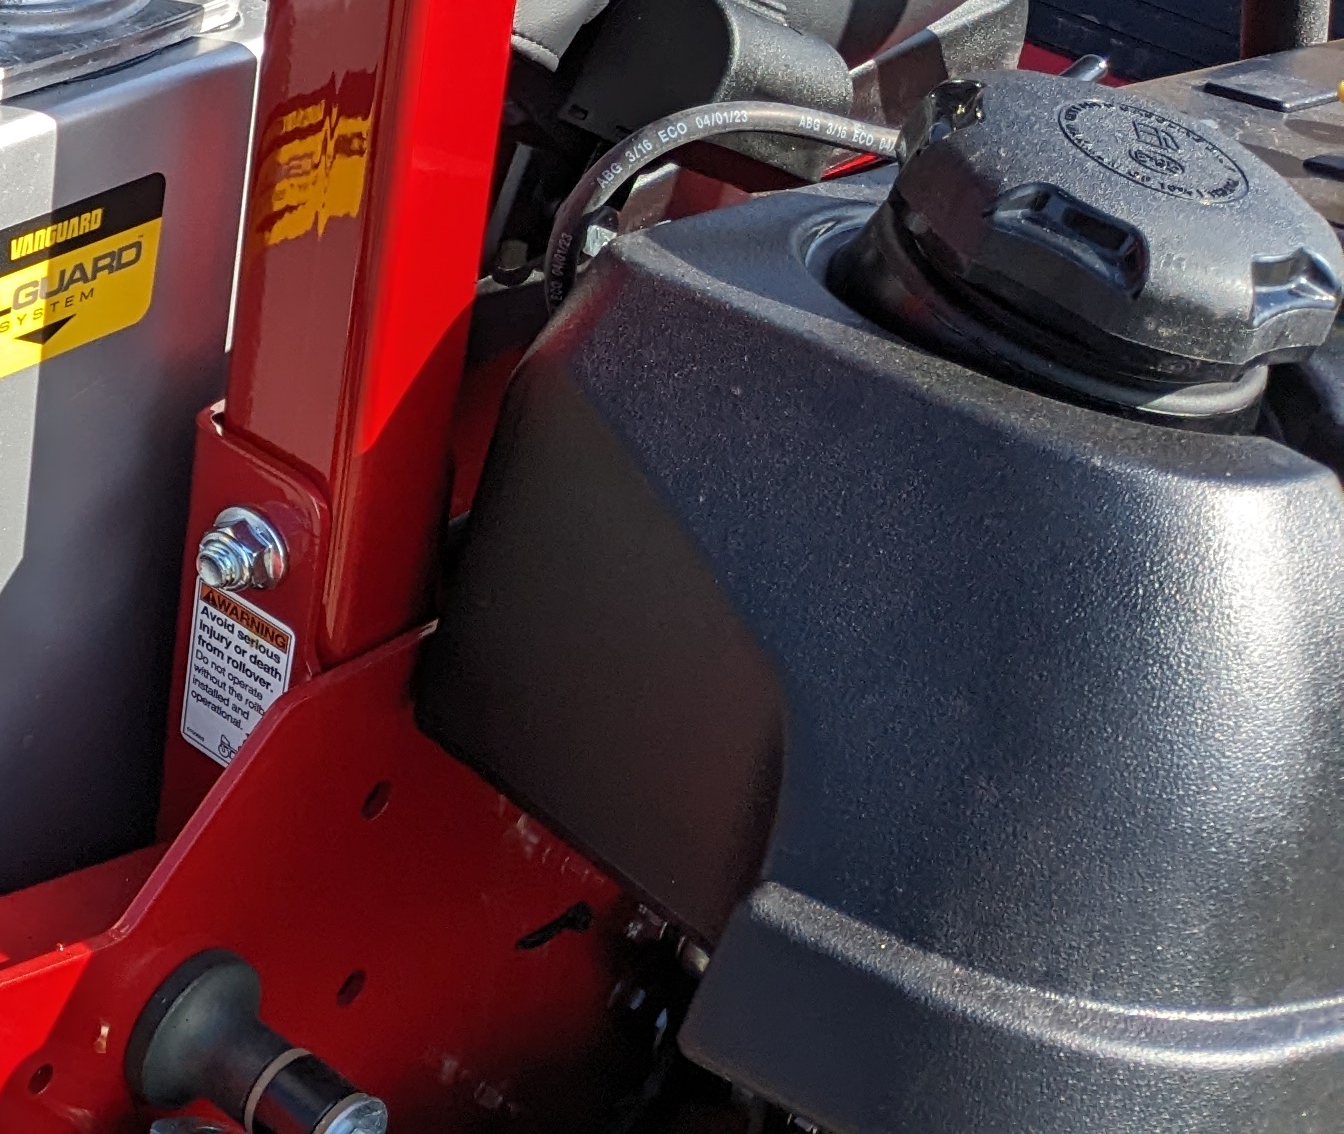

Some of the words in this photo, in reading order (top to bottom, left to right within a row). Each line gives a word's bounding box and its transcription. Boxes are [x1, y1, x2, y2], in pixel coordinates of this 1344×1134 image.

[596, 163, 623, 189] ABG
[625, 139, 653, 162] 3/16
[658, 122, 688, 144] ECO
[696, 110, 748, 129] 04/01/23
[799, 115, 821, 133] ABG
[826, 121, 848, 139] 3/16
[852, 128, 874, 147] ECO
[9, 207, 104, 261] VANGUARD
[200, 606, 235, 634] Avoid
[237, 630, 281, 664] serious
[215, 596, 286, 649] WARNING
[195, 649, 209, 665] Do
[210, 662, 226, 677] not
[227, 672, 263, 701] operate
[197, 635, 224, 660] from
[226, 656, 274, 693] rollover.
[199, 619, 232, 649] injury
[234, 644, 248, 657] or
[249, 653, 282, 682] death
[192, 675, 230, 707] installed
[231, 704, 250, 720] and
[194, 664, 227, 691] without
[228, 684, 243, 702] the
